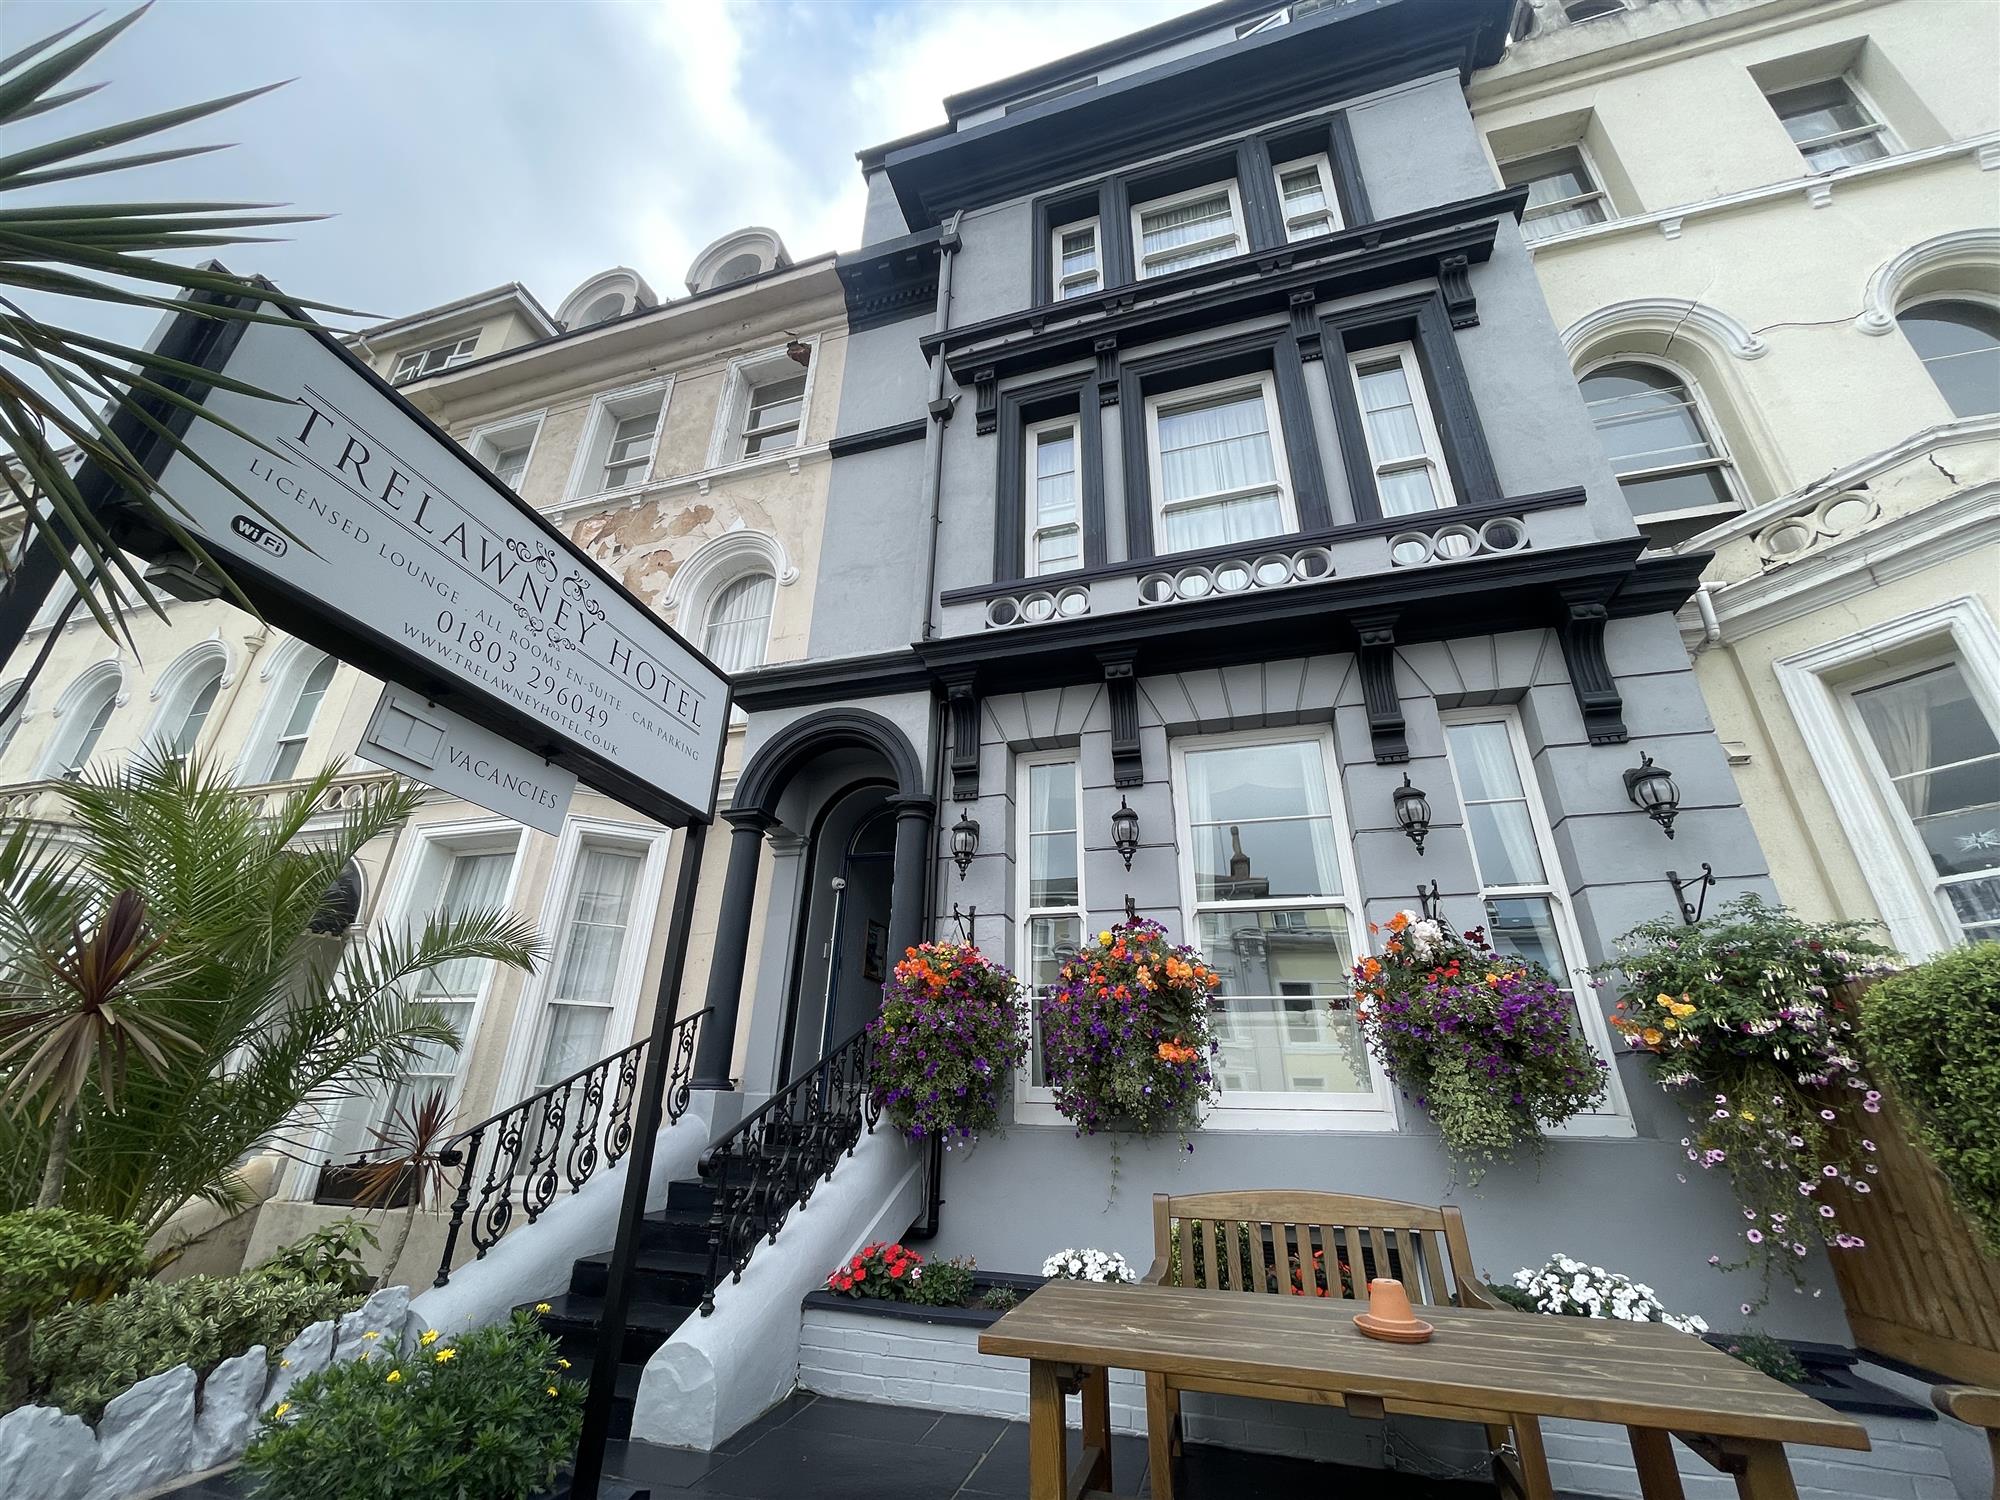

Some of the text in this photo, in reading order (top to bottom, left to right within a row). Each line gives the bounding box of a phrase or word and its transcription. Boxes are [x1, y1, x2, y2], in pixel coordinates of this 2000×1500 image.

[249, 458, 699, 761] LICENSED LOUNGE ALL ROOMS EN-SUITE CAR PARKING
[295, 396, 702, 728] TRELAWNEY HOTEL
[403, 622, 619, 757] WWW.TRELAWNEYHOTEL.CO.UK
[436, 610, 609, 729] 01803 296049
[449, 745, 559, 809] VACANCIES
